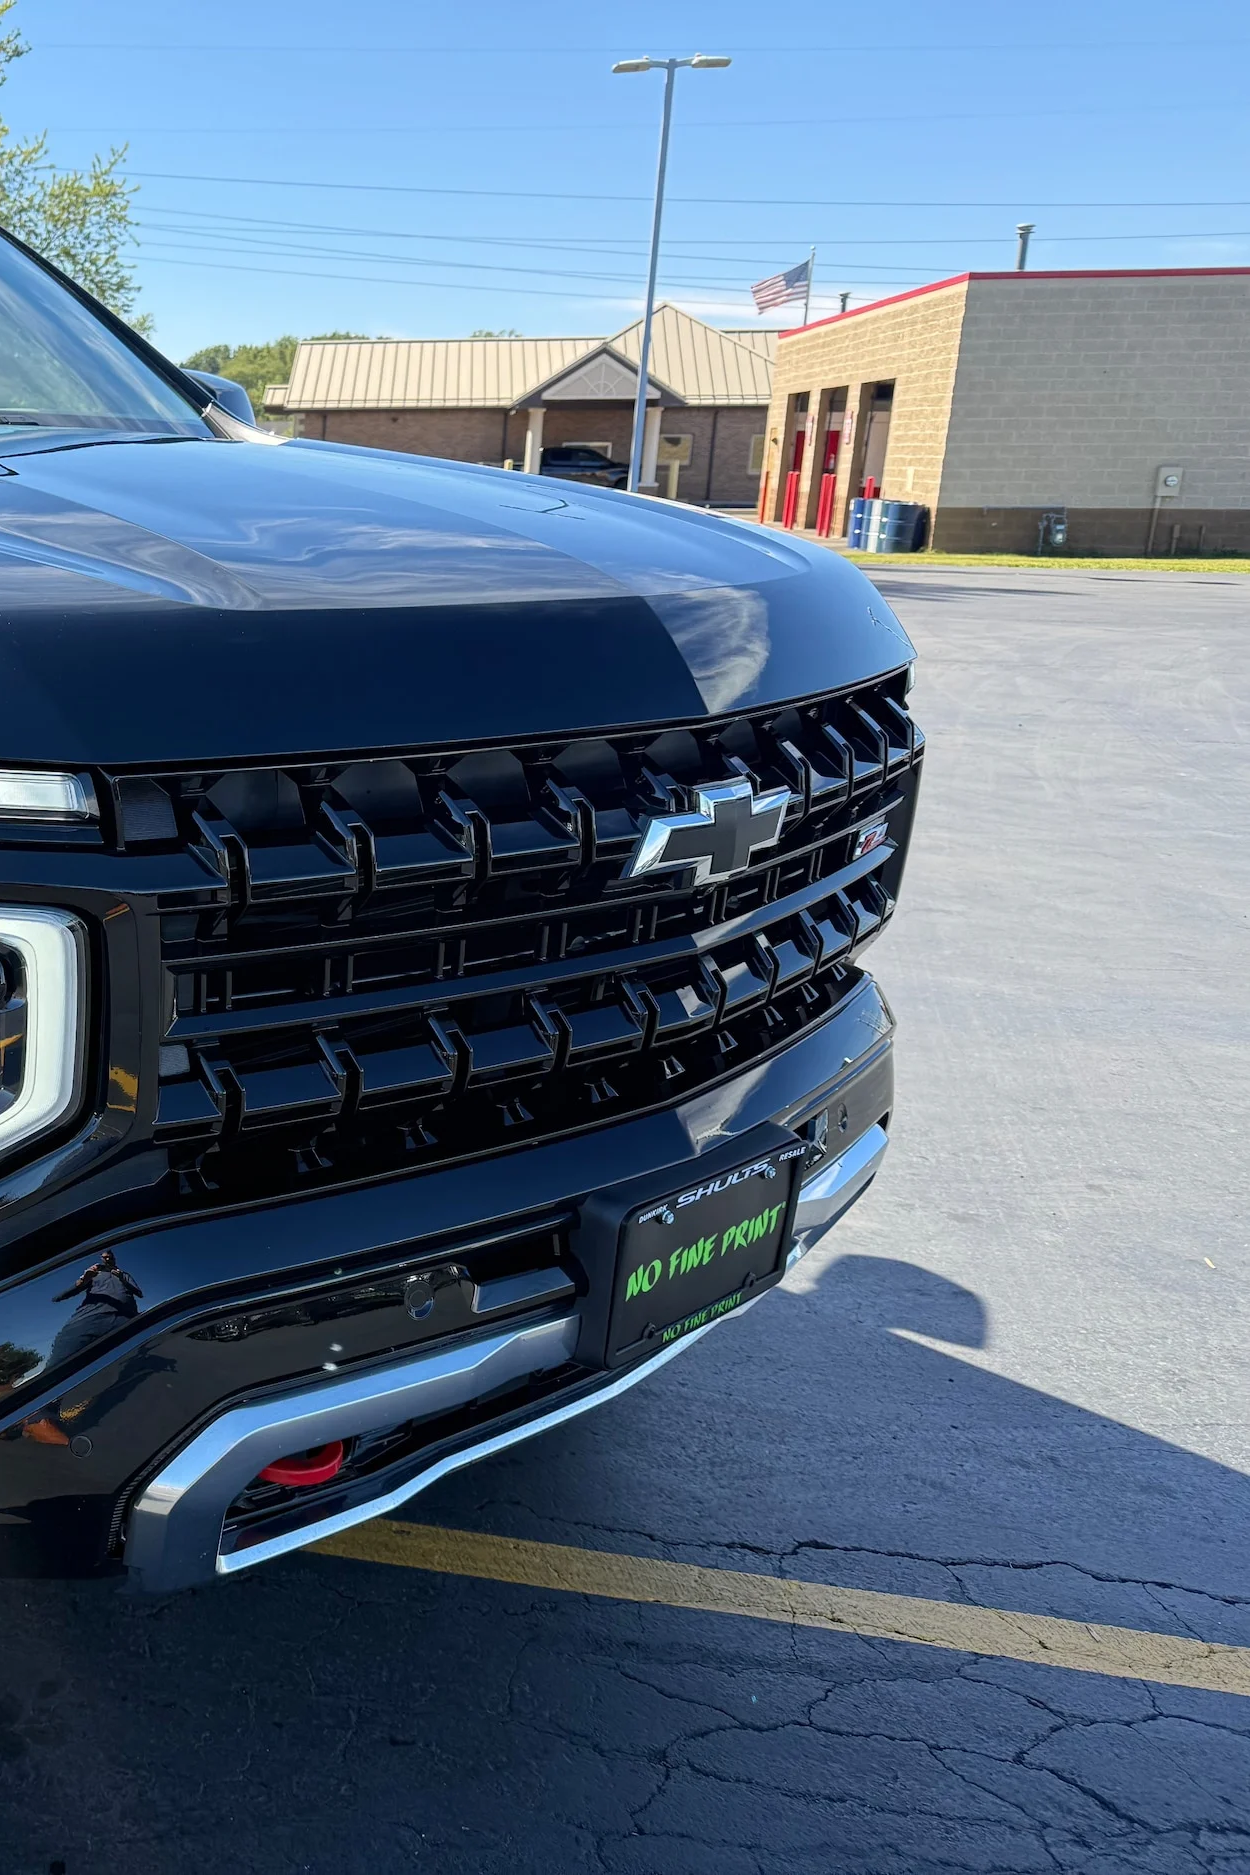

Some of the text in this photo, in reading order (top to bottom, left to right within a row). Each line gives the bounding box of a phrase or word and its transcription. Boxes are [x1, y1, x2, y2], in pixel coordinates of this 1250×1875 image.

[778, 1146, 806, 1162] RESALE
[676, 1158, 771, 1209] SHULTS
[638, 1204, 669, 1225] DUNKIRK
[625, 1259, 663, 1302] NO
[668, 1233, 719, 1280] FINE
[661, 1292, 743, 1344] NO FINE PRINT
